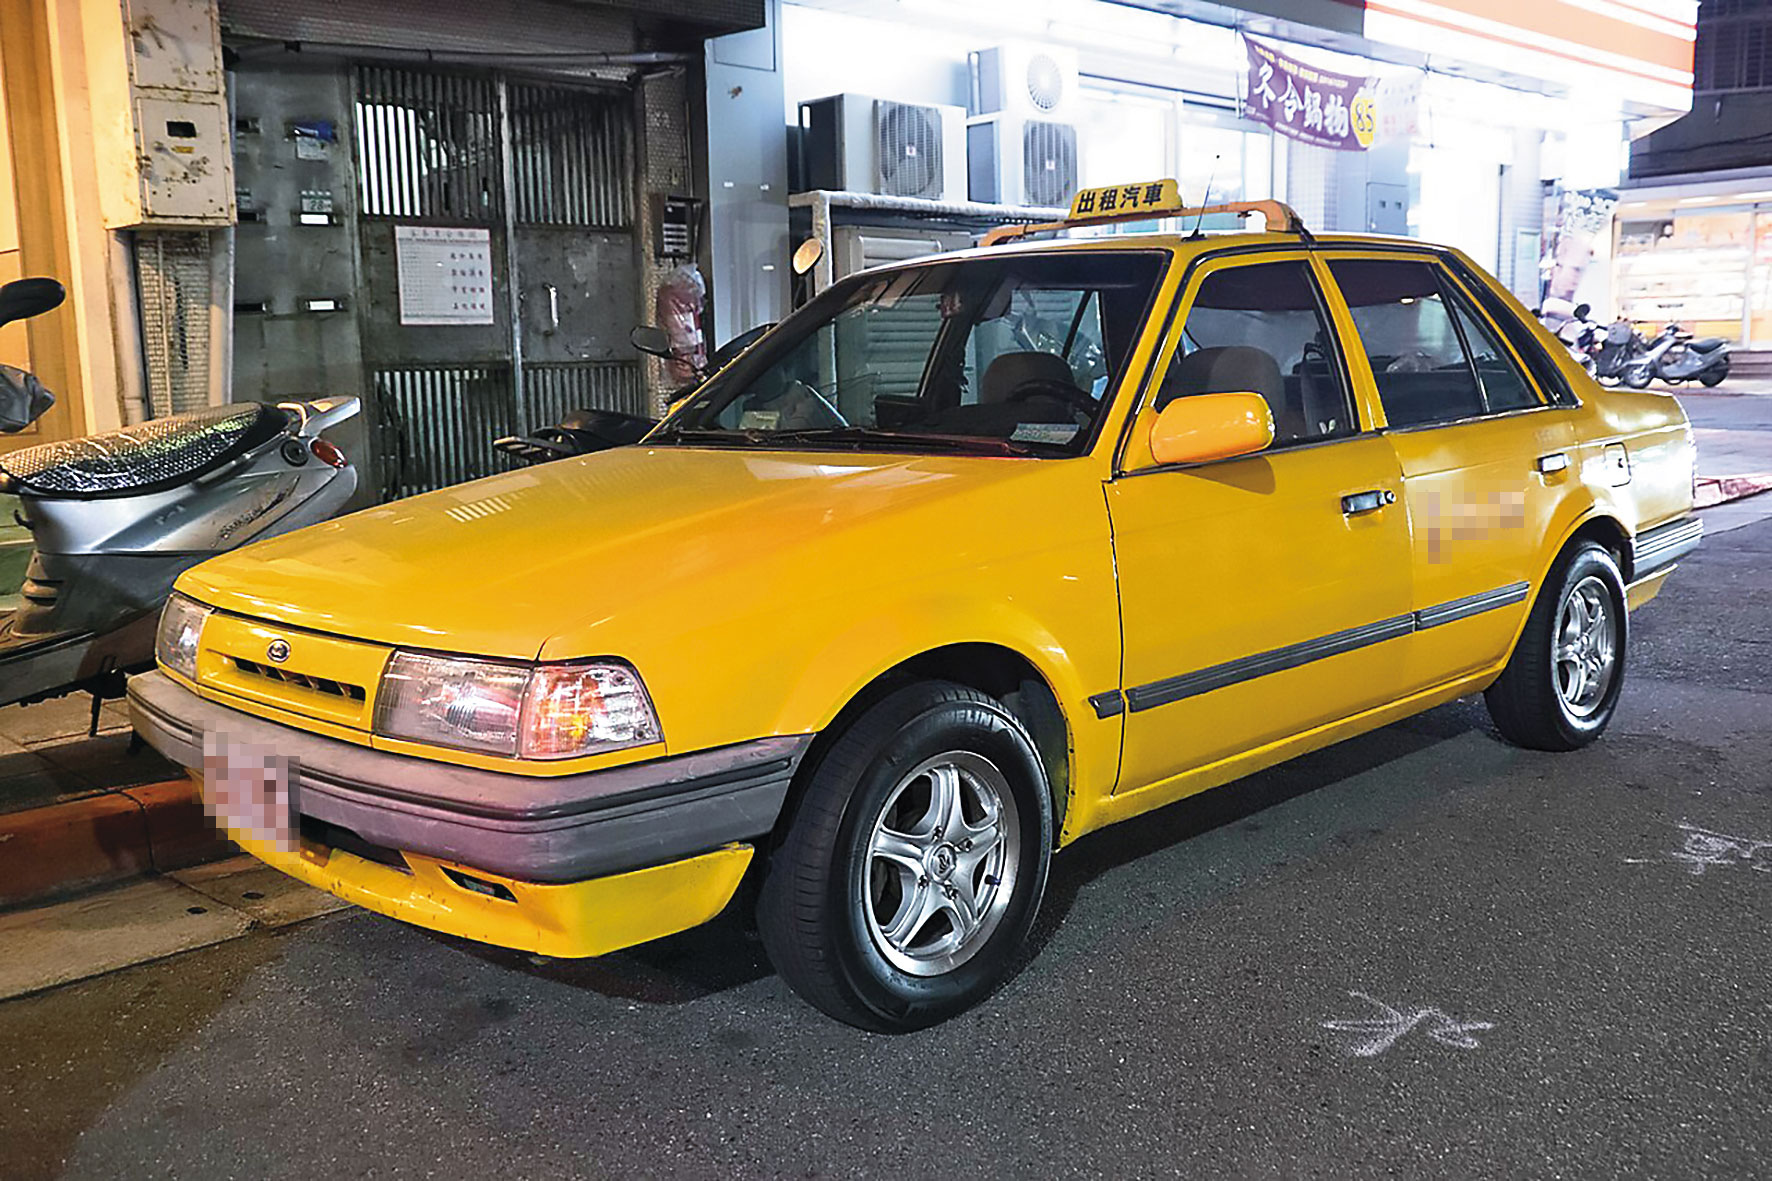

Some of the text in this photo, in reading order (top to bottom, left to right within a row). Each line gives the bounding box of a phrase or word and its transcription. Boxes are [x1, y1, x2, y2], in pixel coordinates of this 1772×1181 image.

[1355, 103, 1375, 132] 85
[1077, 183, 1163, 214] 出租汽車
